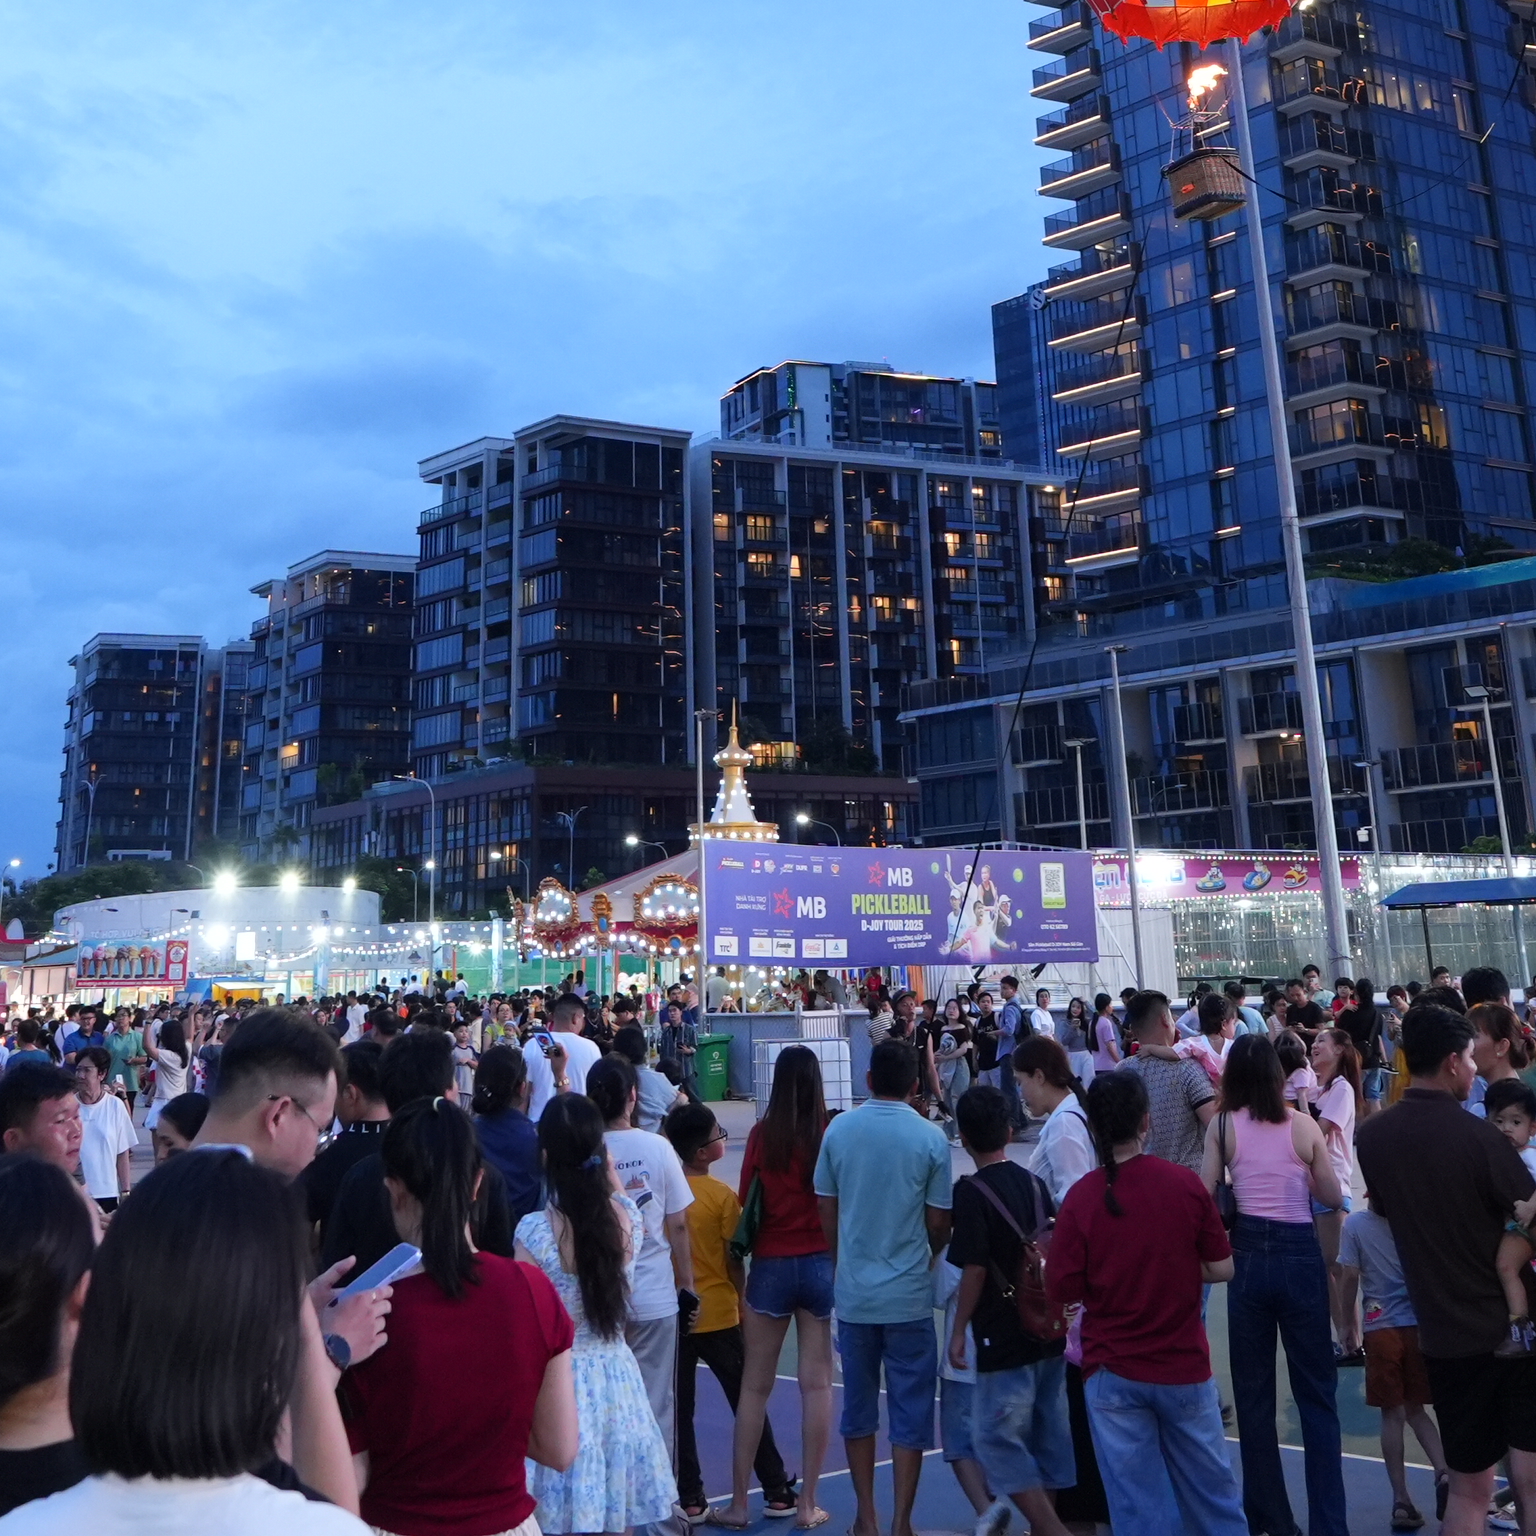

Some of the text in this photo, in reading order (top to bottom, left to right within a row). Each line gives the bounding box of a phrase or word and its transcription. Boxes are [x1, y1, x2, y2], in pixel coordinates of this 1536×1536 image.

[887, 867, 914, 887] MB
[796, 896, 827, 919] MB
[851, 894, 932, 915] PICKLEBALL
[861, 919, 924, 932] D-JOY TOUR 2025
